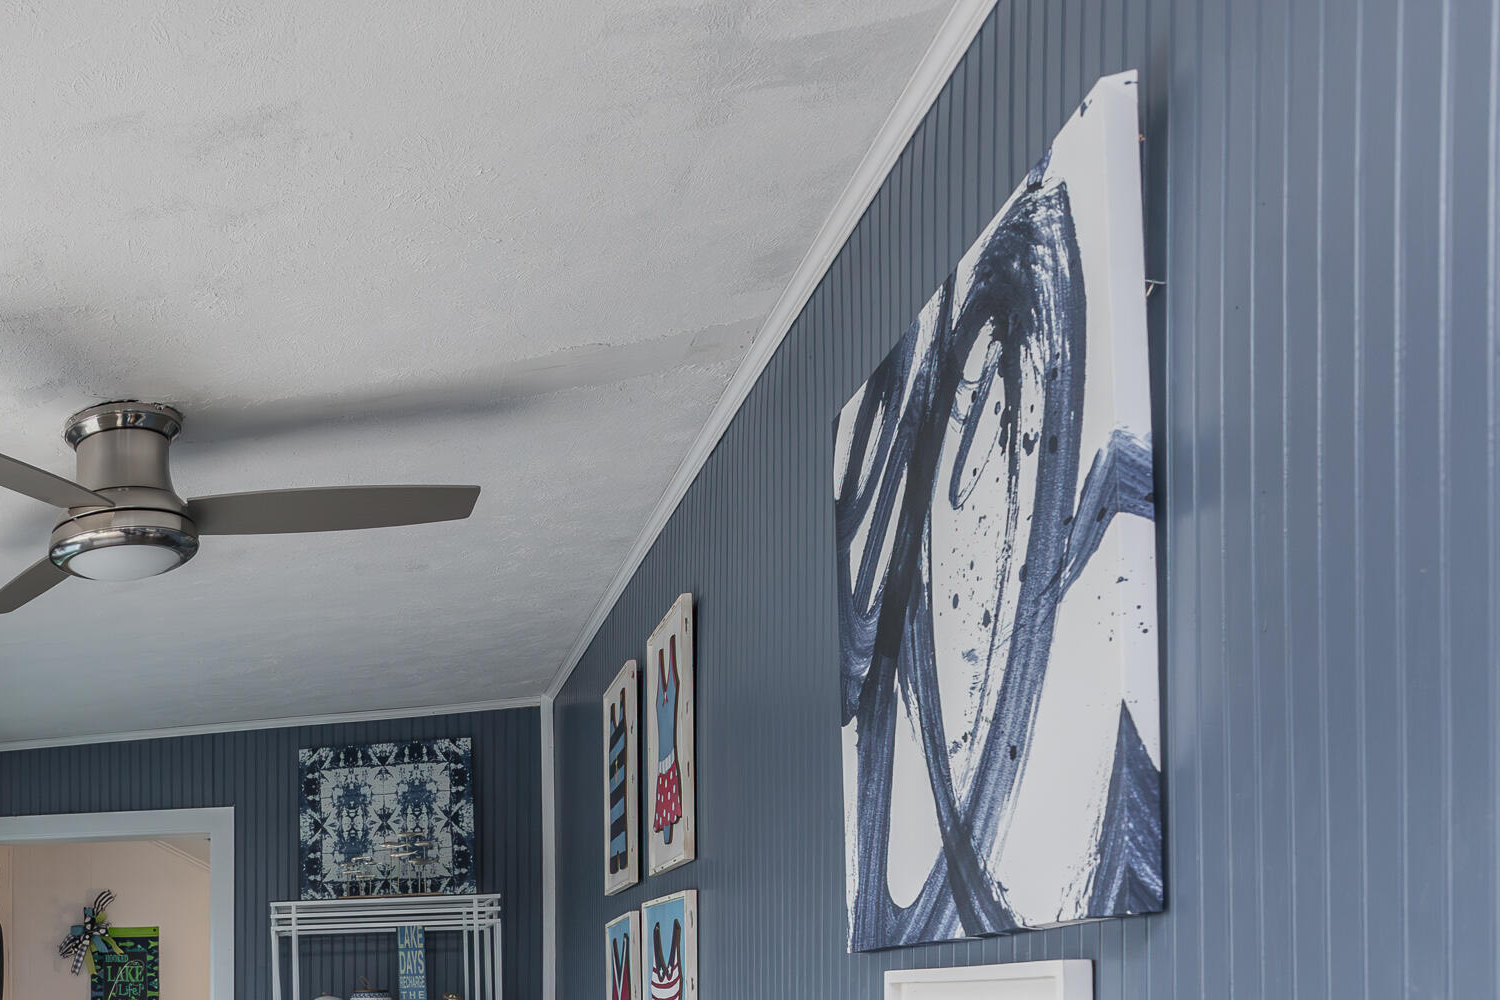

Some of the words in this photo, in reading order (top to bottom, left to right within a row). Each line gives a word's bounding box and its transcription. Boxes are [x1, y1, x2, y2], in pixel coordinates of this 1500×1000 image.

[398, 925, 424, 949] LAKE
[399, 950, 425, 975] DAYS
[107, 966, 144, 982] LAKE
[399, 975, 425, 989] RECHARGE
[401, 990, 425, 1000] THE
